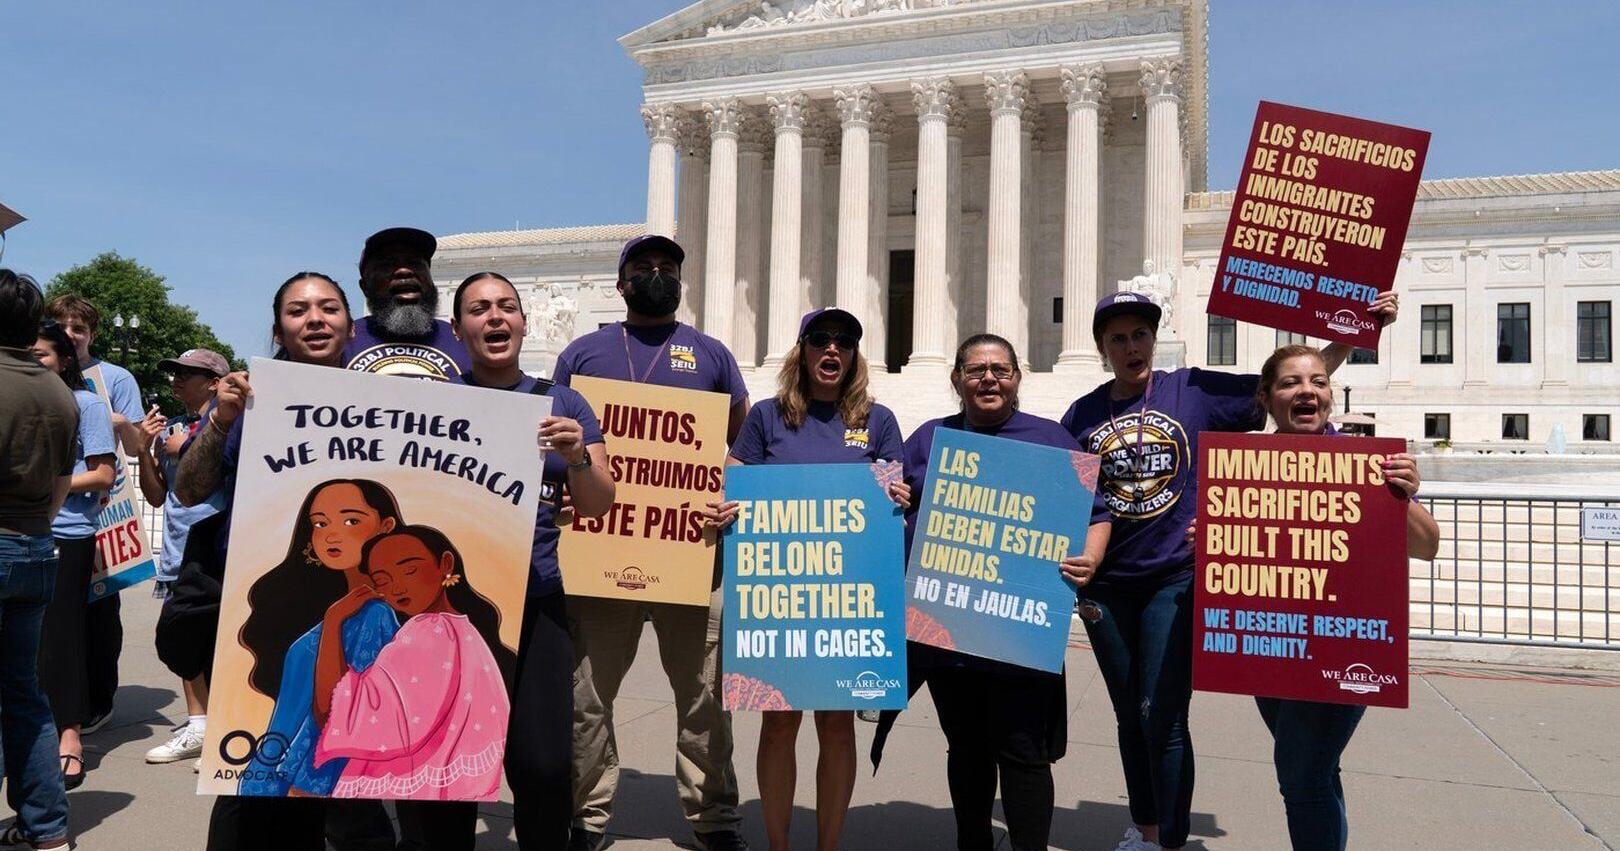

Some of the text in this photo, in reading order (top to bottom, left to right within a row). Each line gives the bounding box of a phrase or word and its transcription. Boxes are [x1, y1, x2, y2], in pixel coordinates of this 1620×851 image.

[1252, 147, 1319, 180] DE LOS
[1259, 121, 1416, 172] LOS SACRIFICIOS
[1245, 173, 1375, 219] INMIGRANTES
[1239, 200, 1386, 250] CONSTRUYERON
[1232, 225, 1329, 267] ESTE PAÍS.
[1225, 256, 1315, 290] MERECEMOS
[1221, 275, 1301, 308] Y DIGNIDAD.
[1315, 310, 1331, 320] WE
[1332, 315, 1352, 325] ARE
[1352, 319, 1375, 331] CASA
[353, 347, 450, 372] 32BJ POLITICAL
[670, 358, 697, 370] SEIU
[285, 405, 481, 446] TOGETHER,
[601, 403, 703, 450] JUNTOS,
[1117, 415, 1176, 436] POLTICAL
[938, 447, 980, 480] LAS
[1101, 453, 1172, 477] POWER
[1108, 444, 1160, 460] WE UILD
[264, 437, 525, 505] WE ARE AMERICA
[606, 454, 722, 493] STRUIMOS
[737, 499, 866, 534] FAMILIES
[932, 479, 1035, 523] FAMILIAS
[1103, 488, 1174, 513] ORGANIZERS
[1206, 485, 1361, 523] SACRIFICES
[1592, 512, 1618, 521] AREA
[926, 510, 1070, 563] DEBEN ESTAR
[1206, 524, 1349, 562] BUILT THIS
[604, 571, 619, 579] WE
[737, 541, 843, 577] BELONG
[920, 542, 1003, 584] UNIDAS.
[1205, 562, 1337, 601] COUNTRY.
[736, 583, 884, 619] TOGETHER.
[913, 576, 1051, 627] NO EN JAULAS.
[1204, 607, 1394, 644] WE DESERVE RESPECT,
[736, 629, 893, 658] NOT IN CAGES.
[1203, 633, 1313, 660] AND DIGNITY.
[836, 679, 901, 688] WE ARE CASA
[1322, 670, 1398, 684] WE ARE CASA
